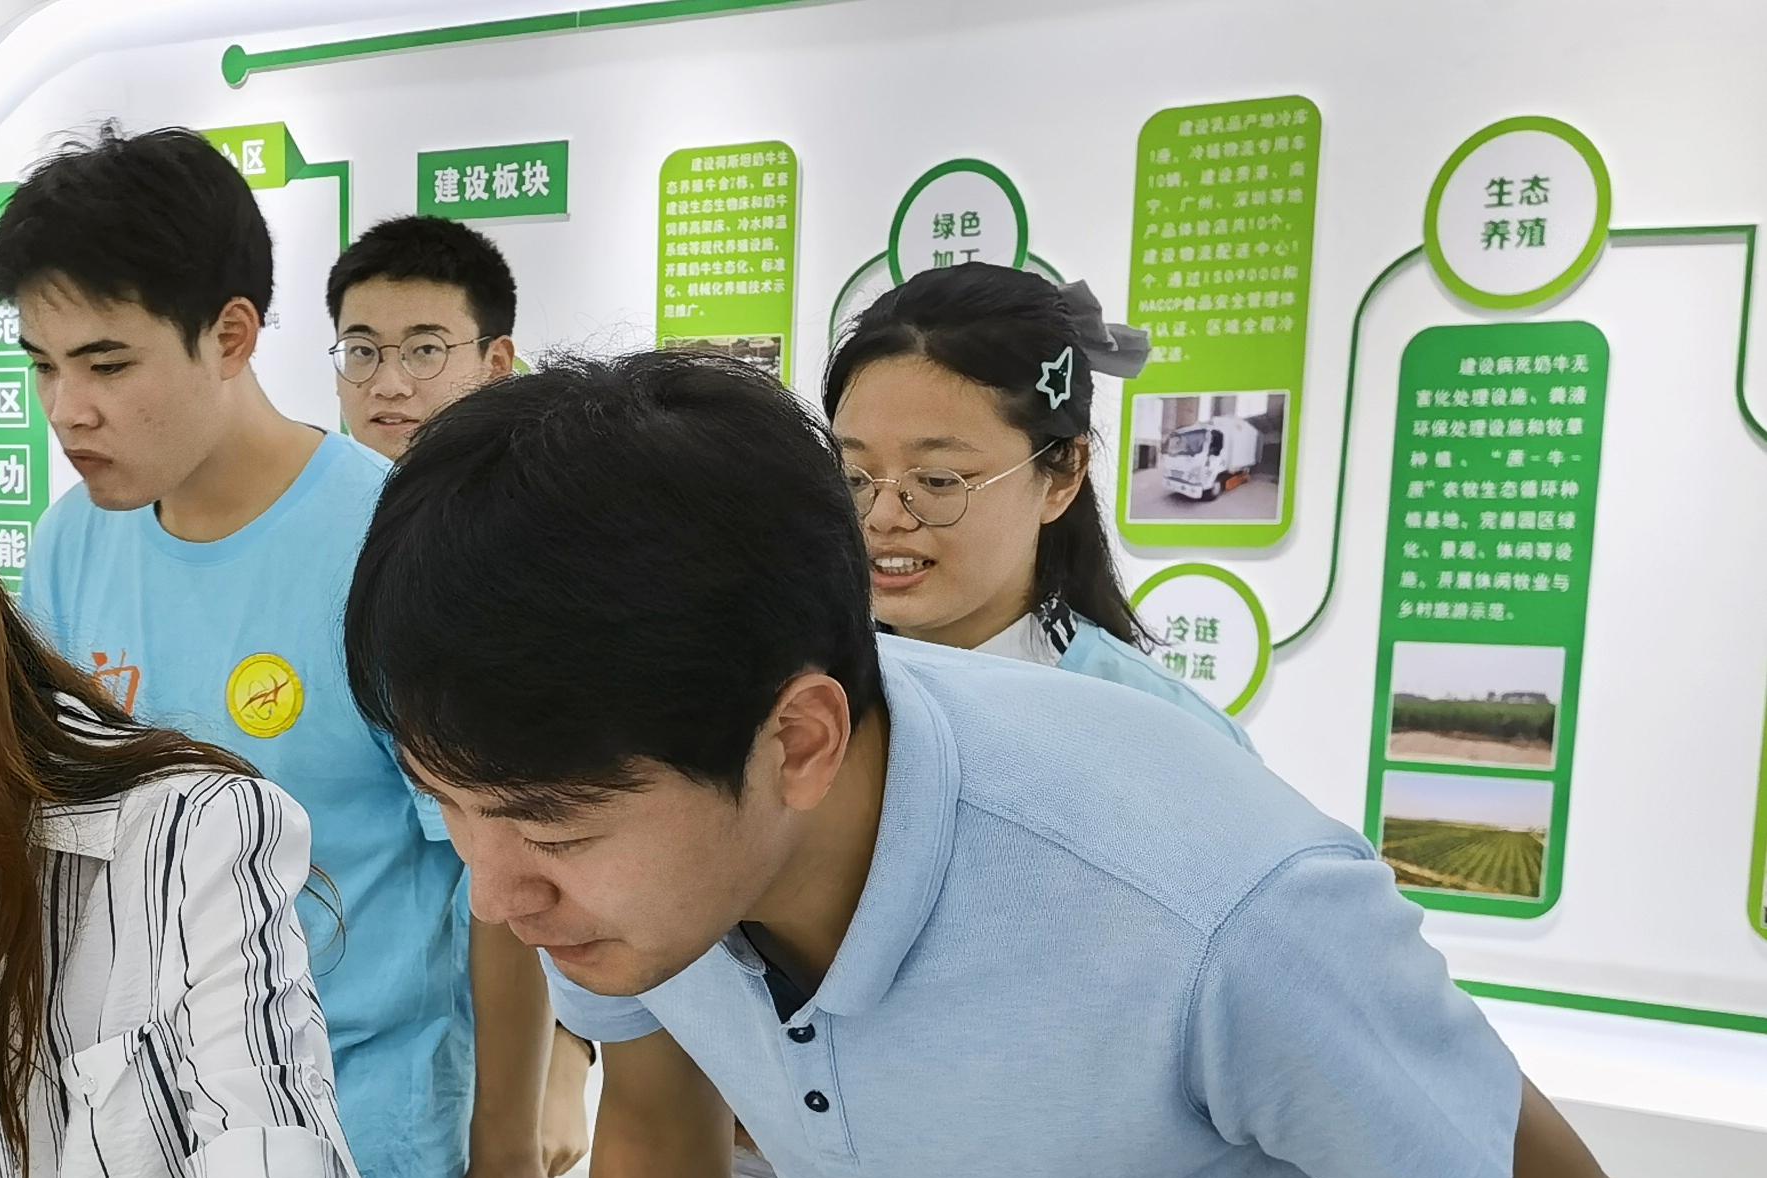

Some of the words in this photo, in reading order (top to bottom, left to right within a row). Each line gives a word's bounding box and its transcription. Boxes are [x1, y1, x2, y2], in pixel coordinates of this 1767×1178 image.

[434, 159, 551, 204] 建设板块
[1483, 174, 1551, 209] 生态
[932, 210, 982, 240] 绿色
[1480, 217, 1548, 251] 养殖
[1165, 614, 1221, 644] 冷链
[1161, 651, 1217, 680] 物流
